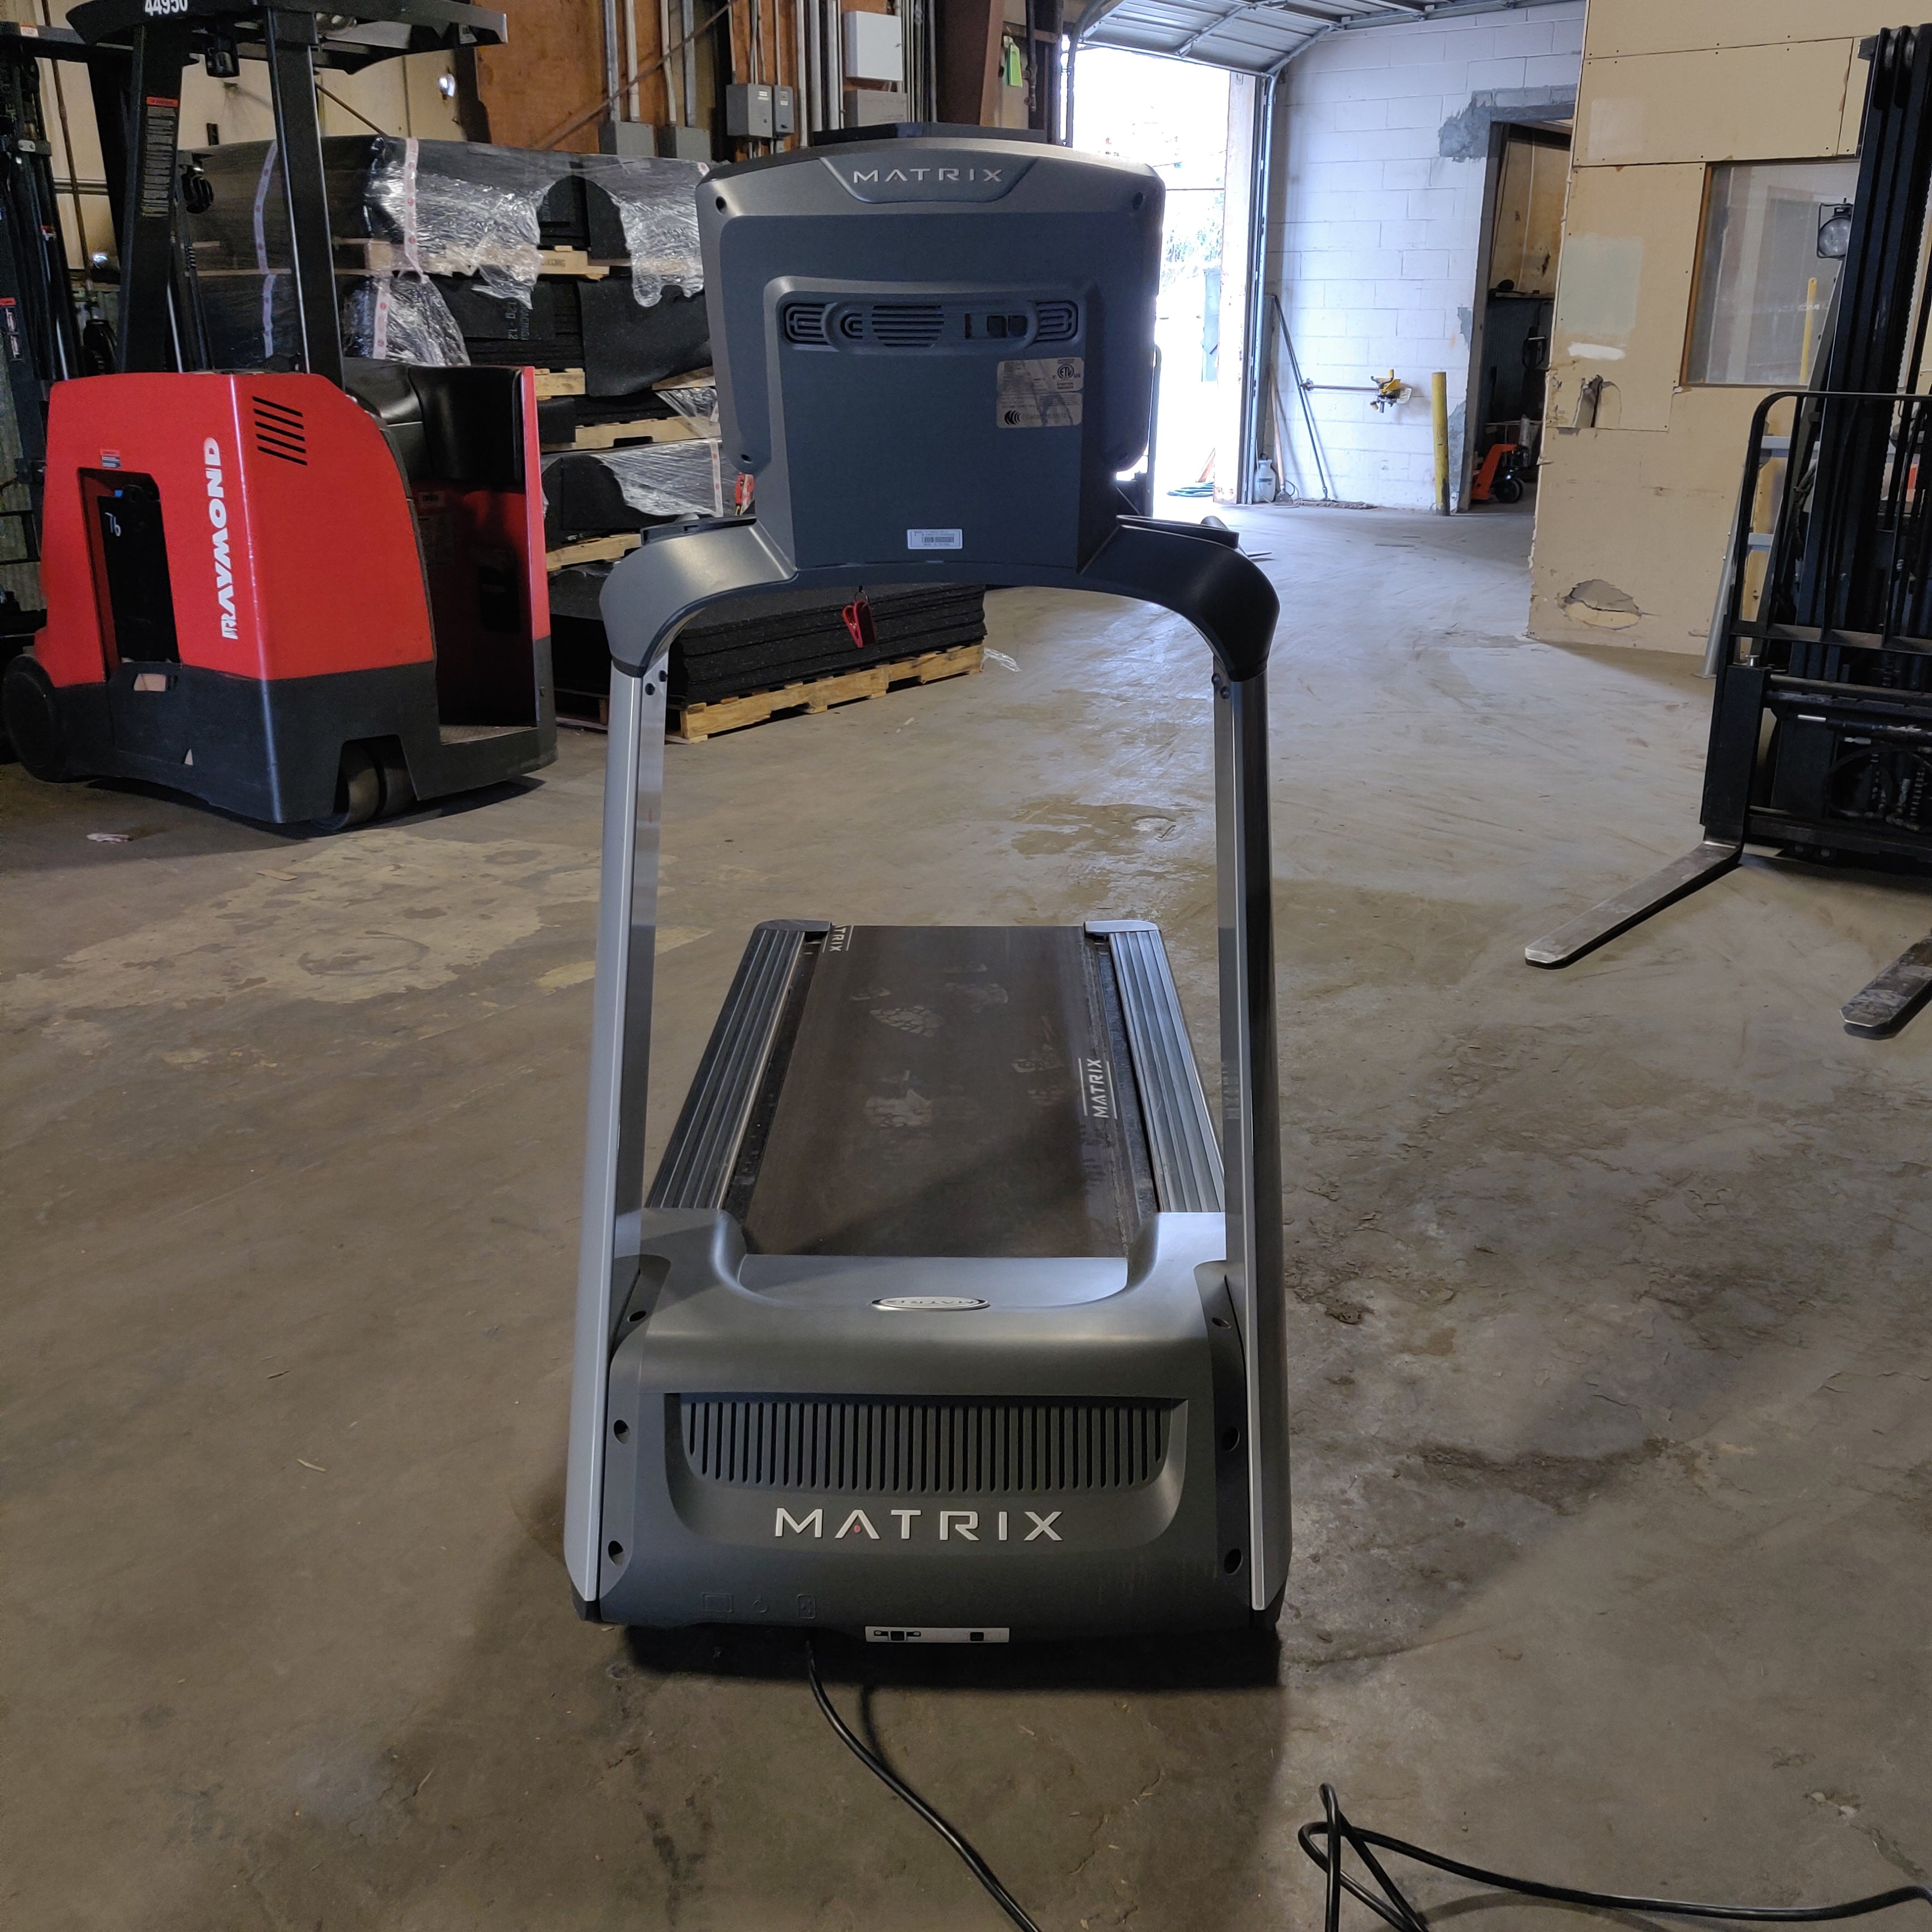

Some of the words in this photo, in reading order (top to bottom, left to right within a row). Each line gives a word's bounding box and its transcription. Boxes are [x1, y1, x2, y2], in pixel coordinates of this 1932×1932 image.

[145, 0, 188, 16] 44950
[853, 168, 1002, 183] MATRIX
[105, 512, 121, 537] 76
[203, 437, 239, 640] RAYMOND
[829, 926, 846, 951] TRIX
[1086, 1058, 1110, 1118] MATRIX
[775, 1508, 1063, 1541] MATRIX
